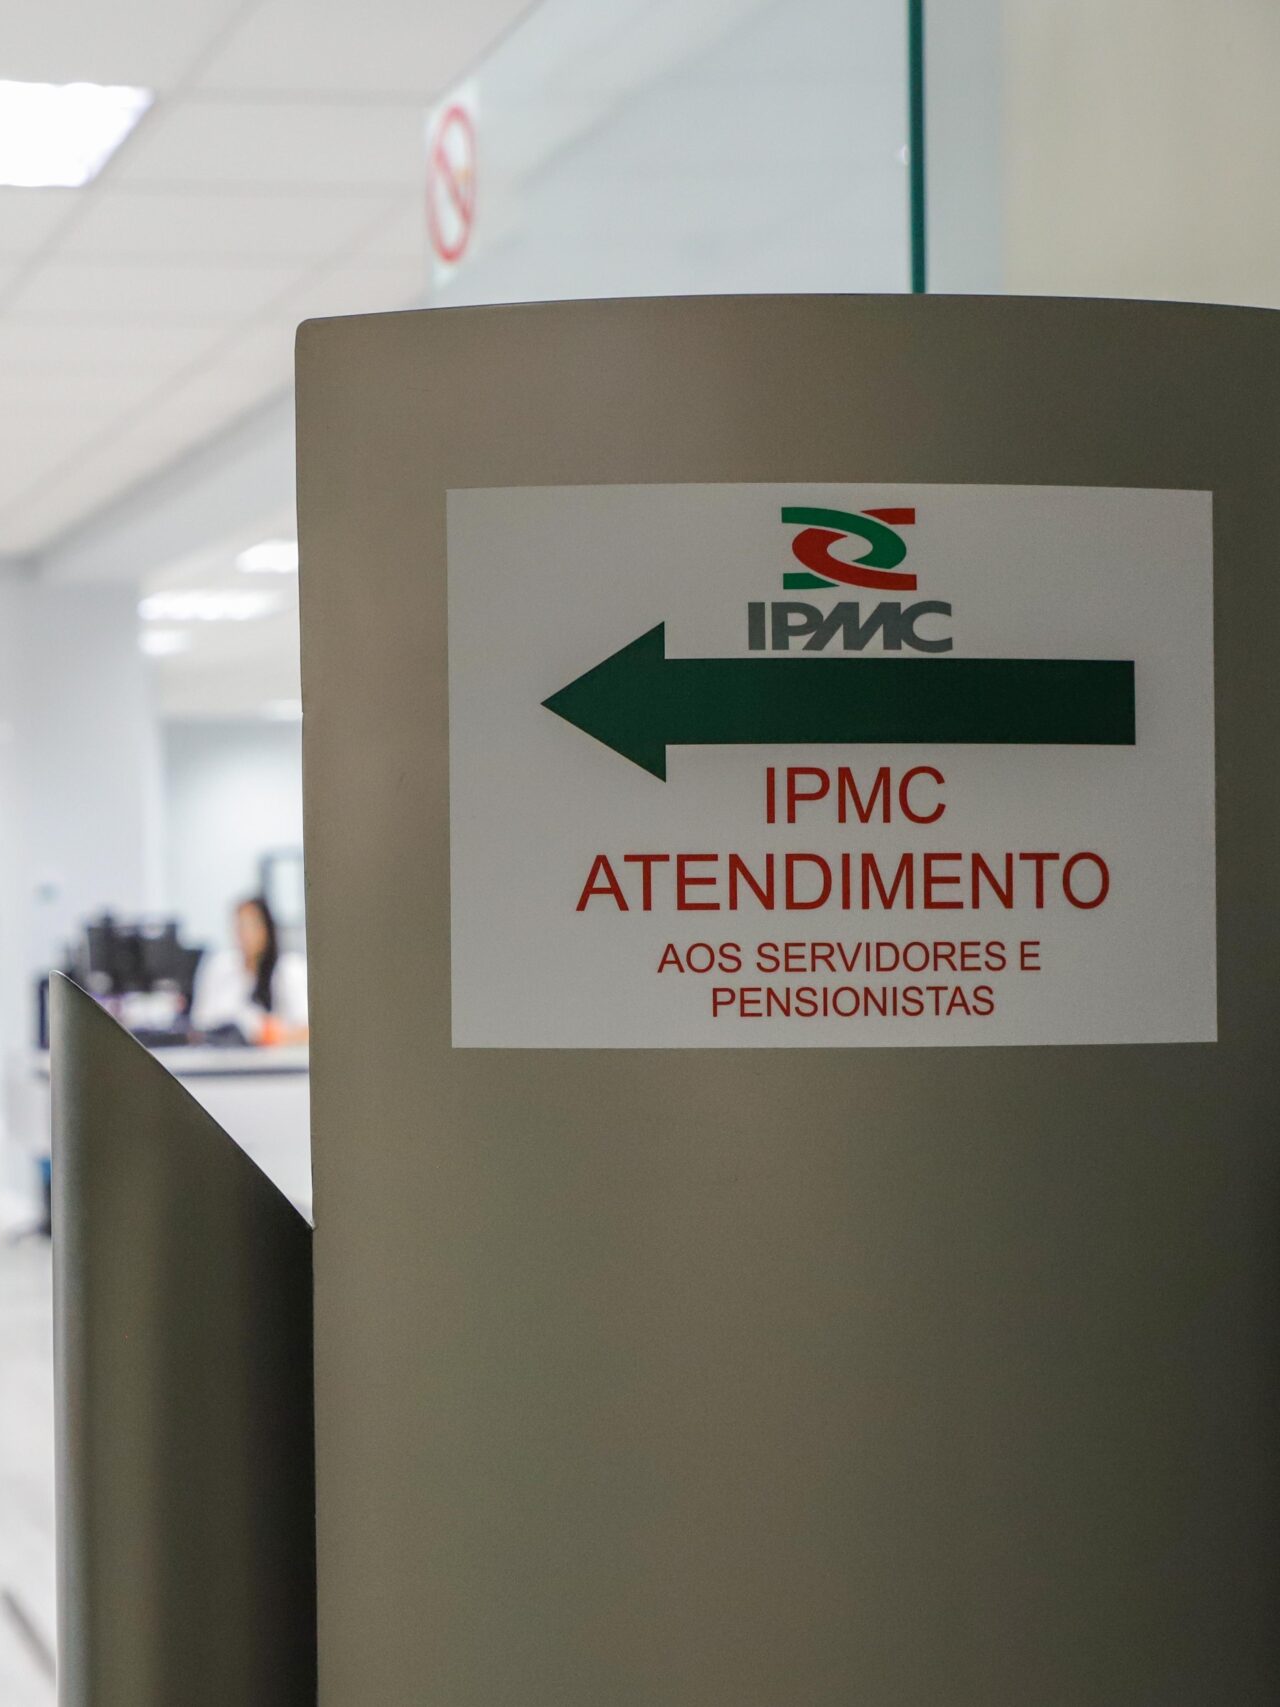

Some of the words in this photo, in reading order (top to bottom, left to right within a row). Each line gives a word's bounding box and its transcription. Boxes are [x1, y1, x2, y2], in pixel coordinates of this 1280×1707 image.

[747, 600, 954, 654] IPMC
[765, 765, 947, 825] IPMC
[576, 851, 1111, 913] ATENDIMENTO
[657, 942, 742, 975] AOS
[756, 941, 1008, 973] SERVIDORES
[1019, 941, 1042, 971] E
[711, 985, 996, 1018] PENSIONISTAS
